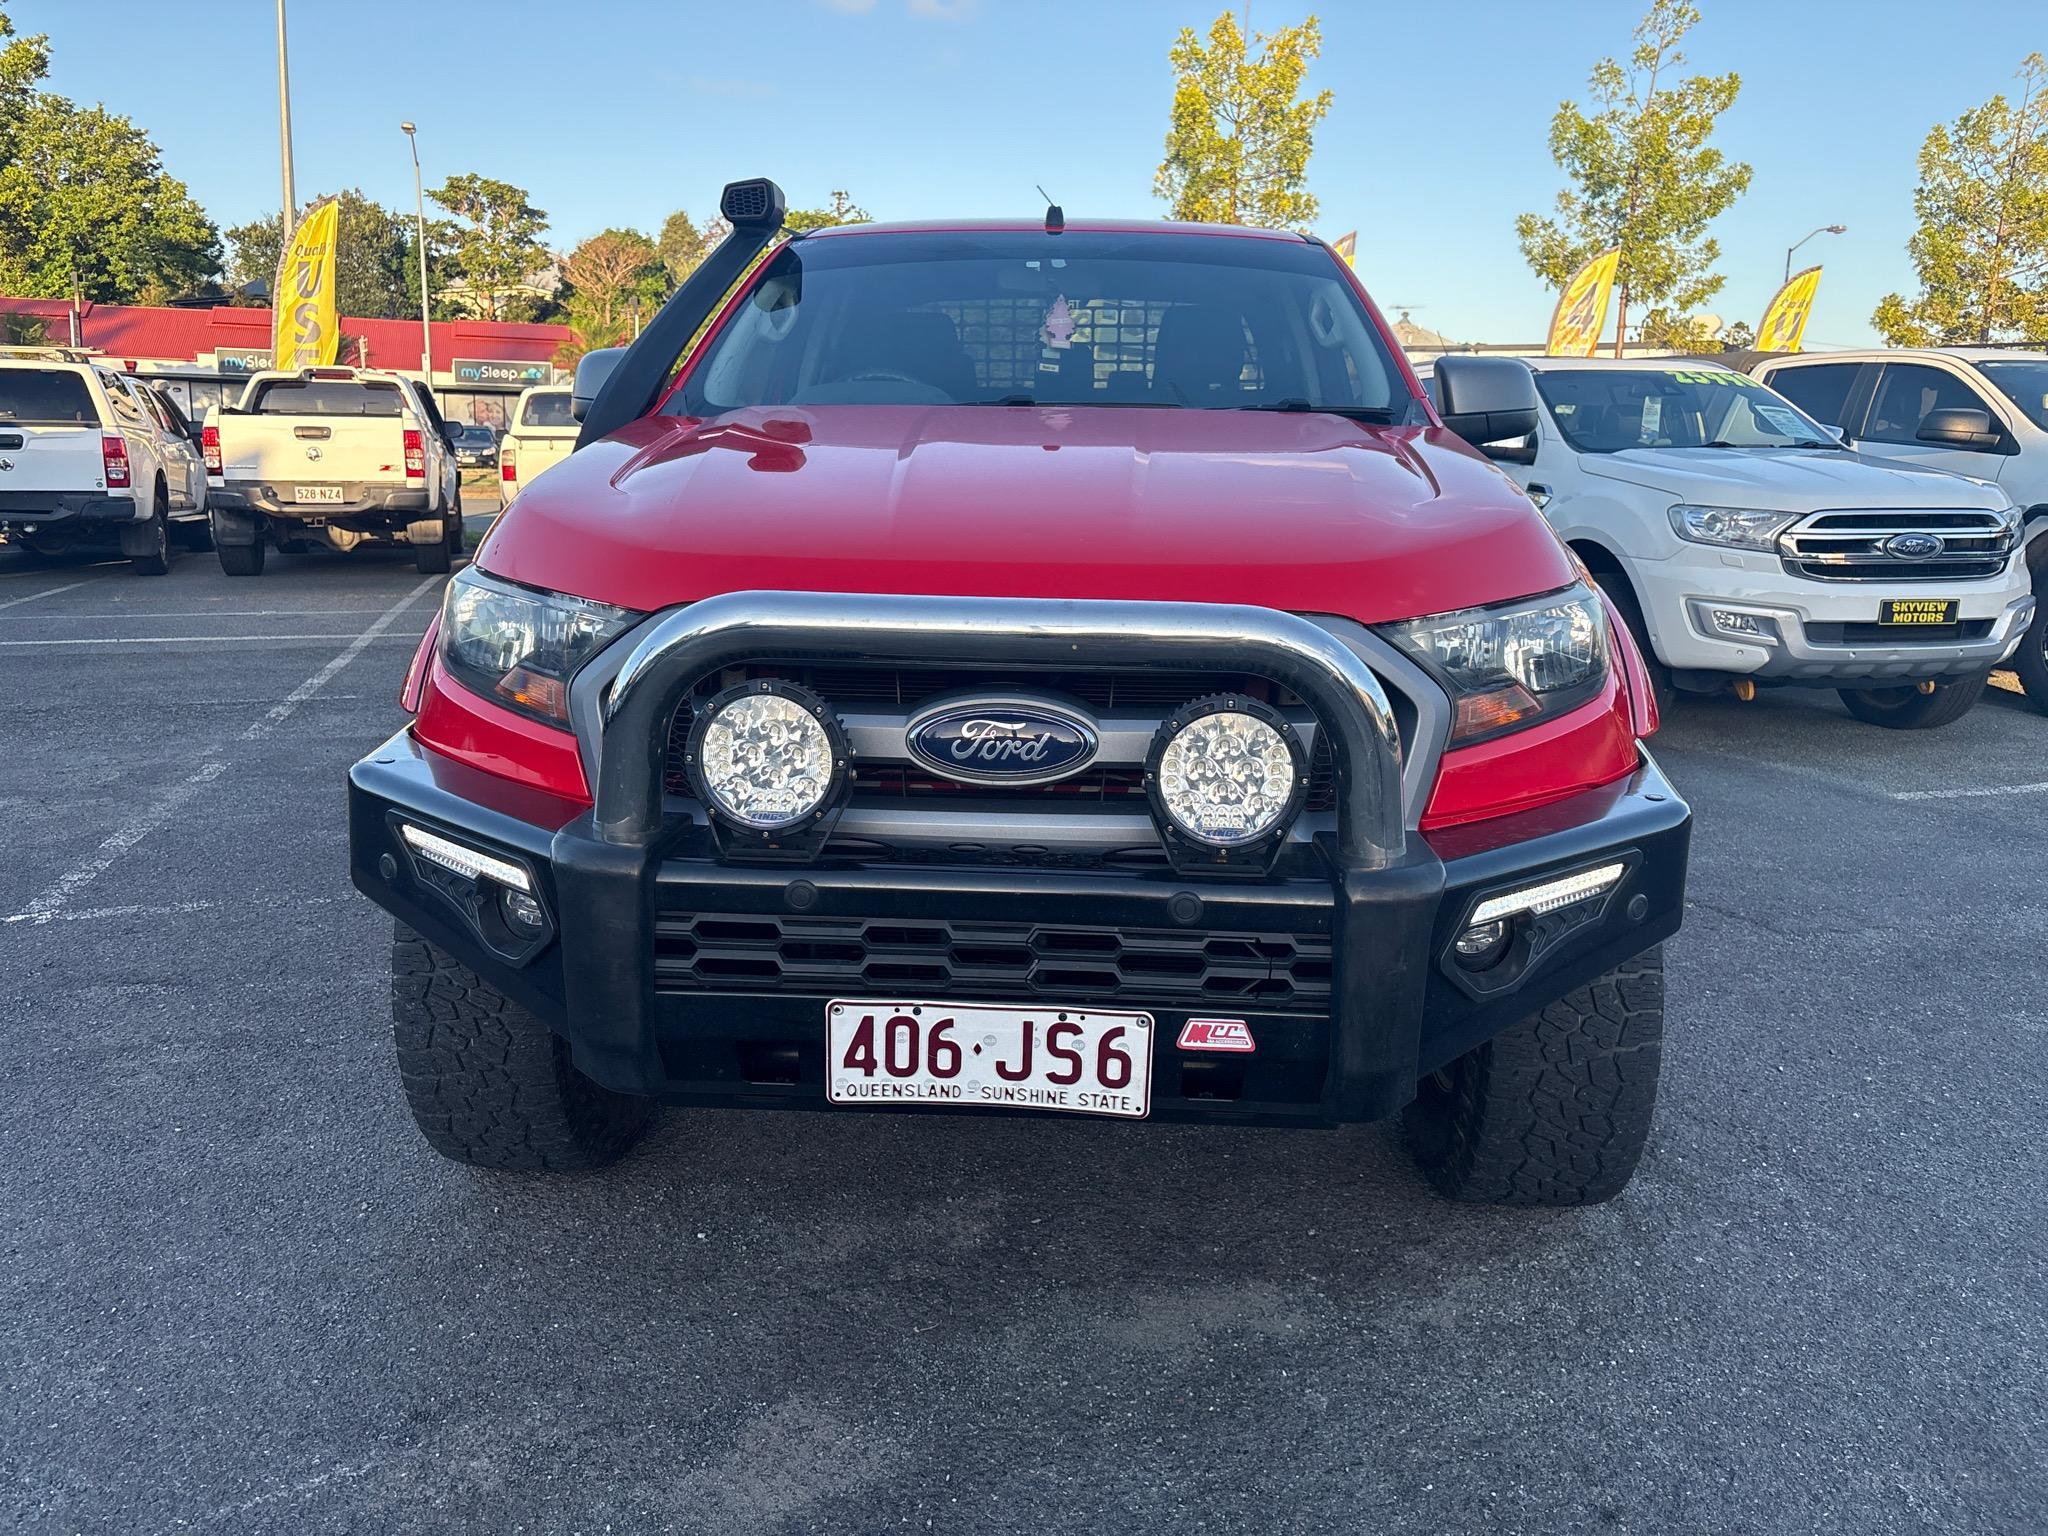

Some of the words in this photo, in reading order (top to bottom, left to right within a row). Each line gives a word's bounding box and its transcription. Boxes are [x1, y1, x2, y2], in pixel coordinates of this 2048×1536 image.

[1905, 538, 1931, 553] Ford
[1892, 602, 1948, 612] SKYVIEW
[1893, 612, 1944, 623] MOTORS
[950, 719, 1050, 762] Ford
[751, 812, 786, 821] KINGS
[1205, 829, 1242, 837] KINGS
[846, 1083, 962, 1098] QUEENSLAND
[981, 1086, 1069, 1105] SUNSHINE
[1078, 1092, 1131, 1111] STATE
